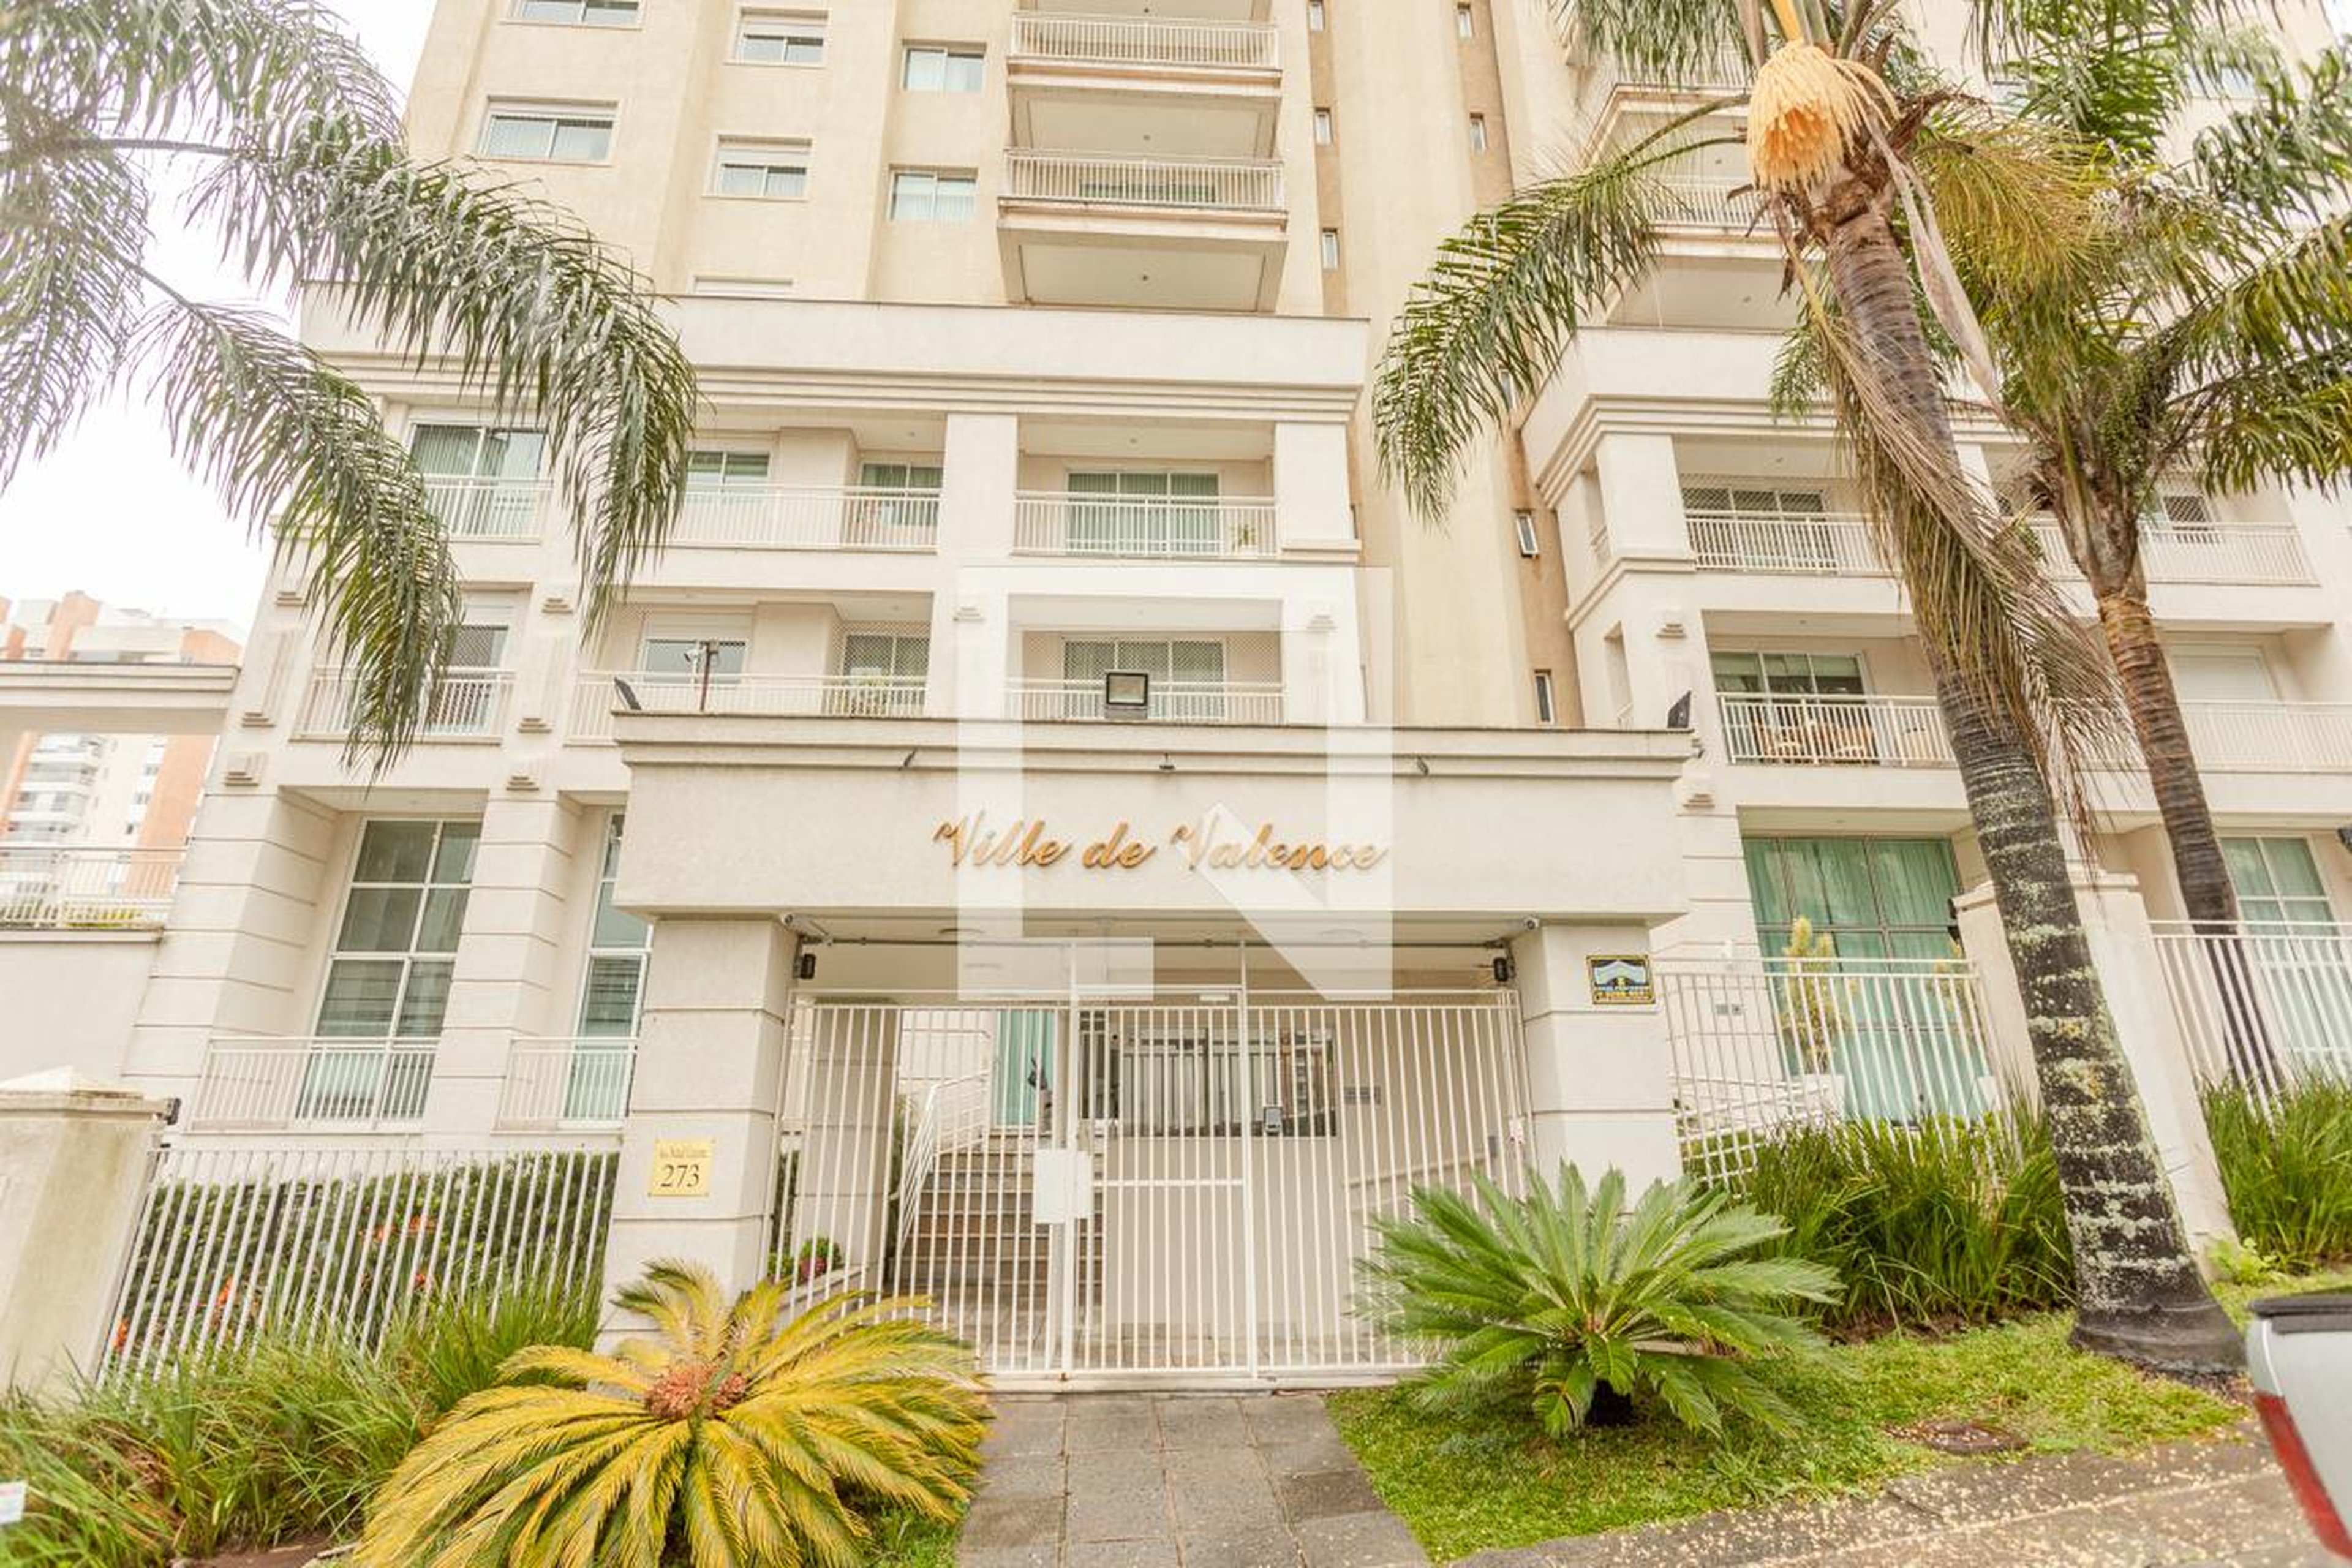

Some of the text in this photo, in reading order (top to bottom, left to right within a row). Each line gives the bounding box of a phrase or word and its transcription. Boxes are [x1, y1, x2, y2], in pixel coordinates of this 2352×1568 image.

[933, 810, 1388, 870] Ville de Valence
[661, 1164, 699, 1187] 273
